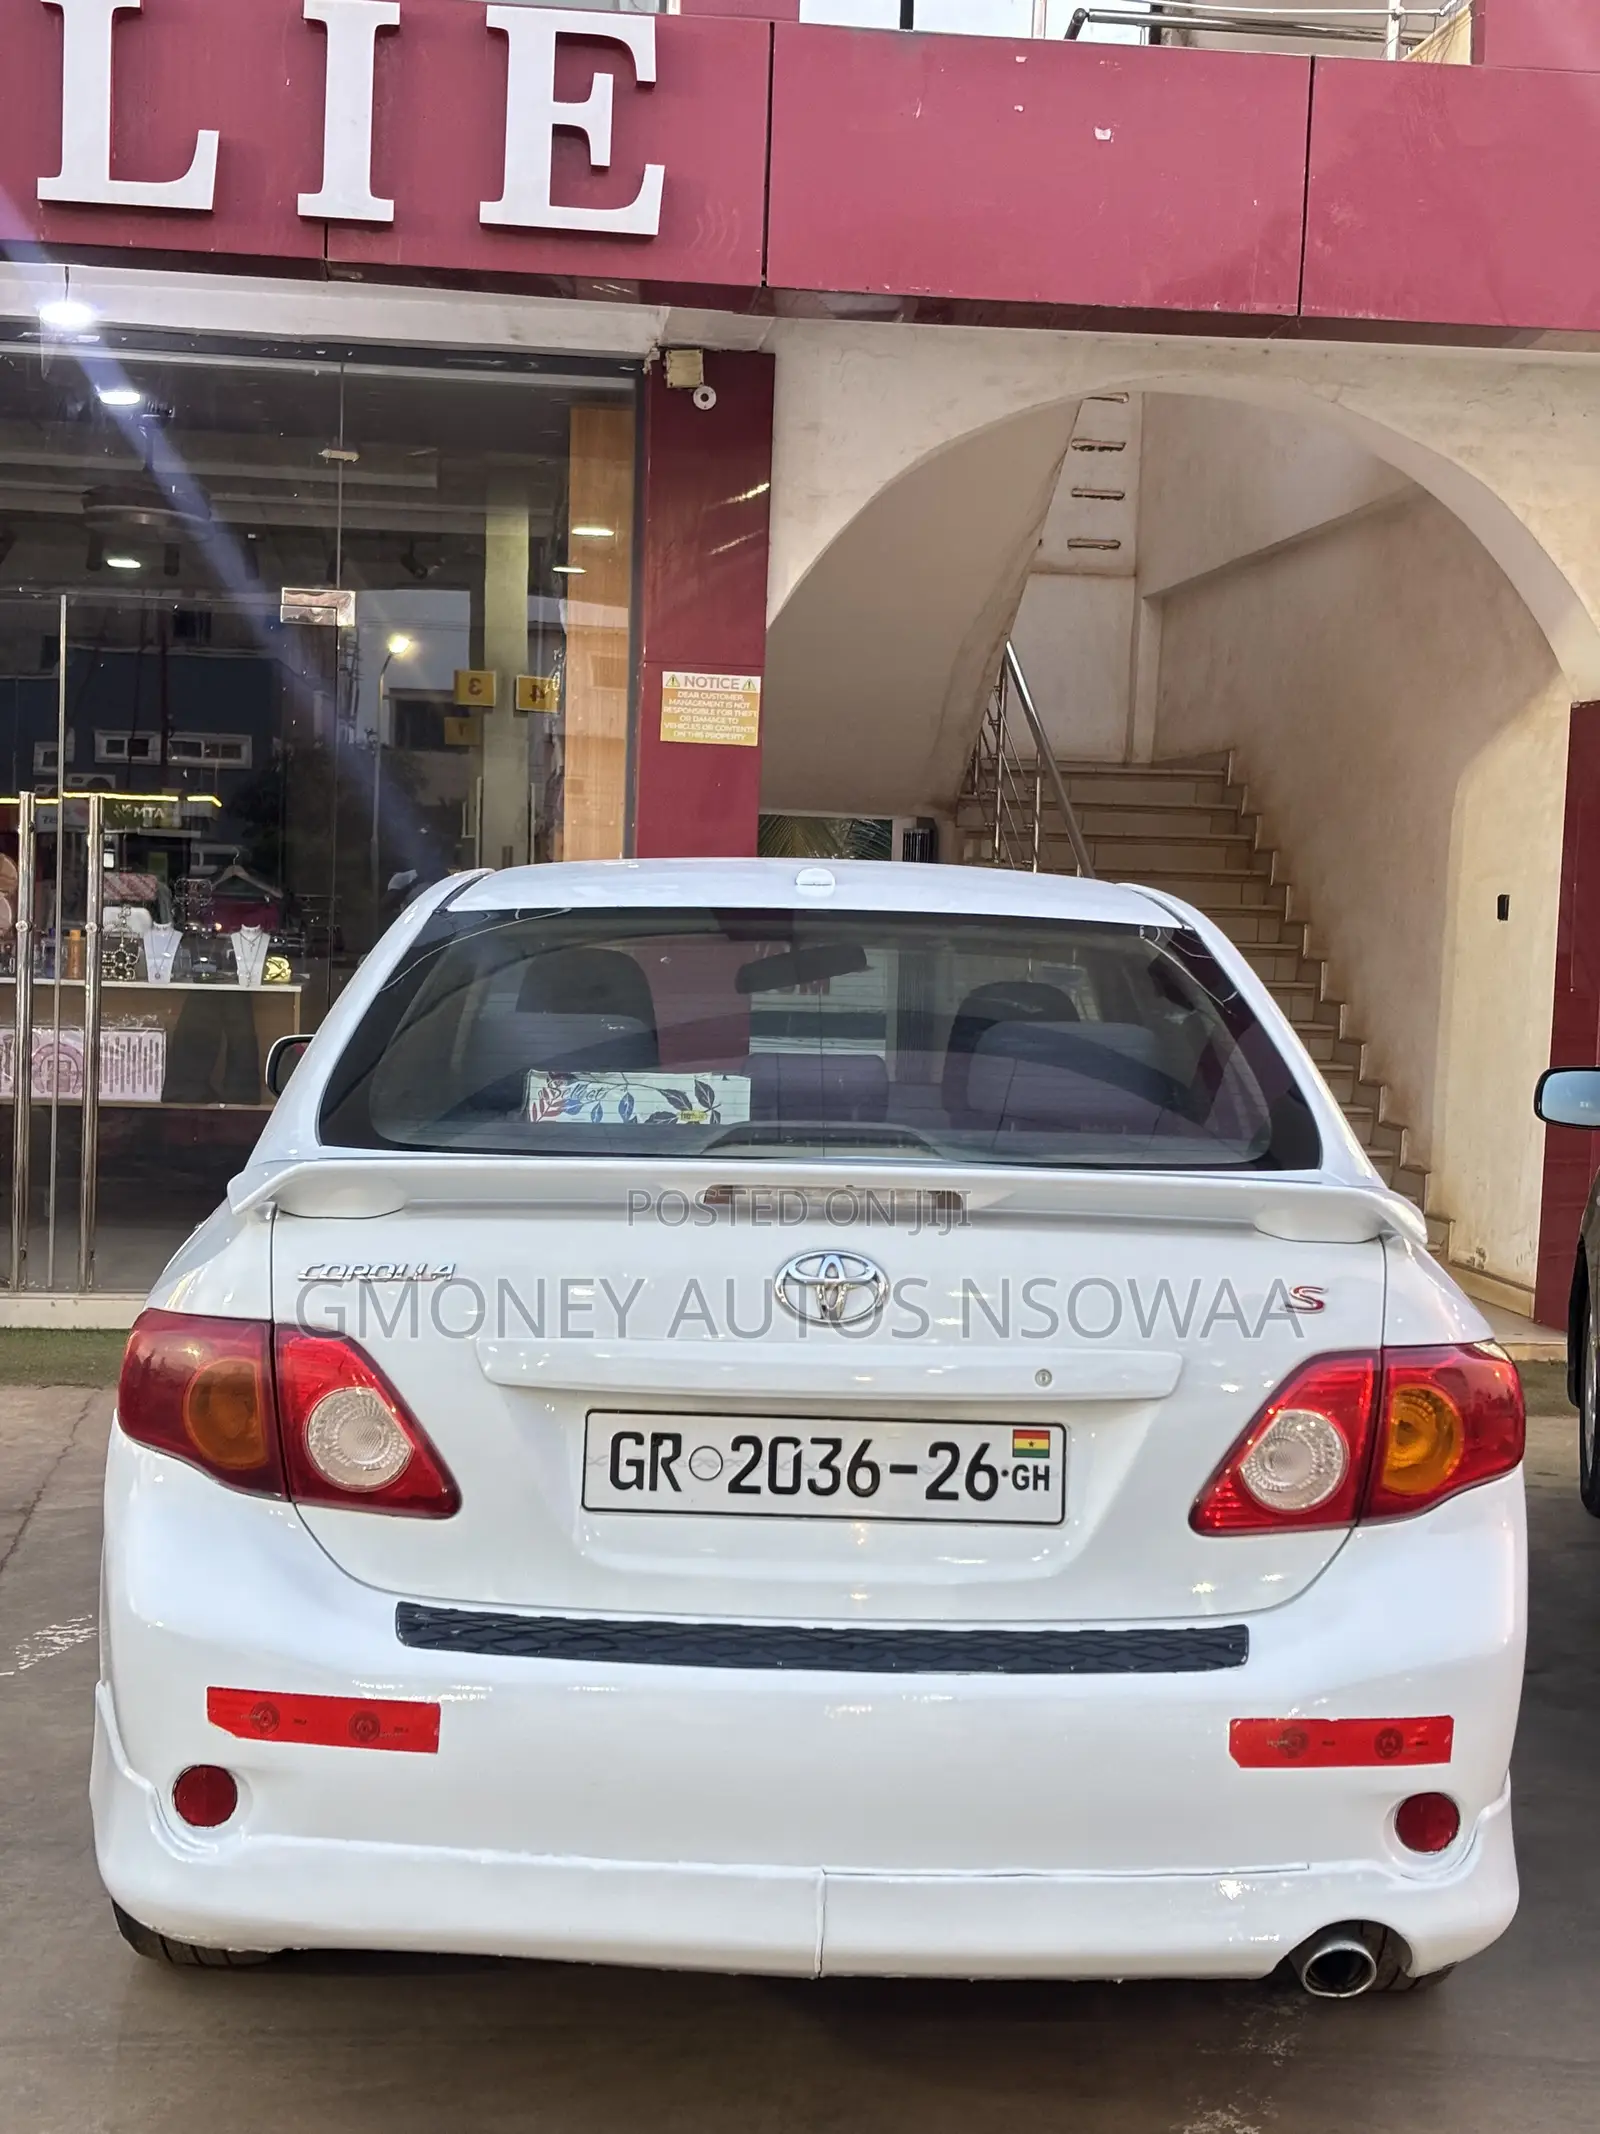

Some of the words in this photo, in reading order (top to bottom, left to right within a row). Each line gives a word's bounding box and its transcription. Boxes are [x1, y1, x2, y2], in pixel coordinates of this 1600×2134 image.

[684, 676, 740, 690] NOTICE
[677, 691, 700, 699] DEAR
[668, 699, 725, 709] MANAGEMENT
[734, 702, 751, 710] NOT
[663, 706, 716, 716] RESPONSIBLE
[716, 709, 733, 717] FOR
[734, 710, 757, 718] THEFT
[680, 715, 692, 723] OR
[692, 716, 726, 724] DAMAGE
[727, 717, 739, 725] TO
[663, 722, 701, 731] VEHICLES
[702, 723, 714, 731] OR
[297, 1262, 455, 1283] COROLLA
[1283, 1285, 1328, 1315] S
[609, 1430, 682, 1492] GR
[727, 1434, 998, 1502] 2036-26
